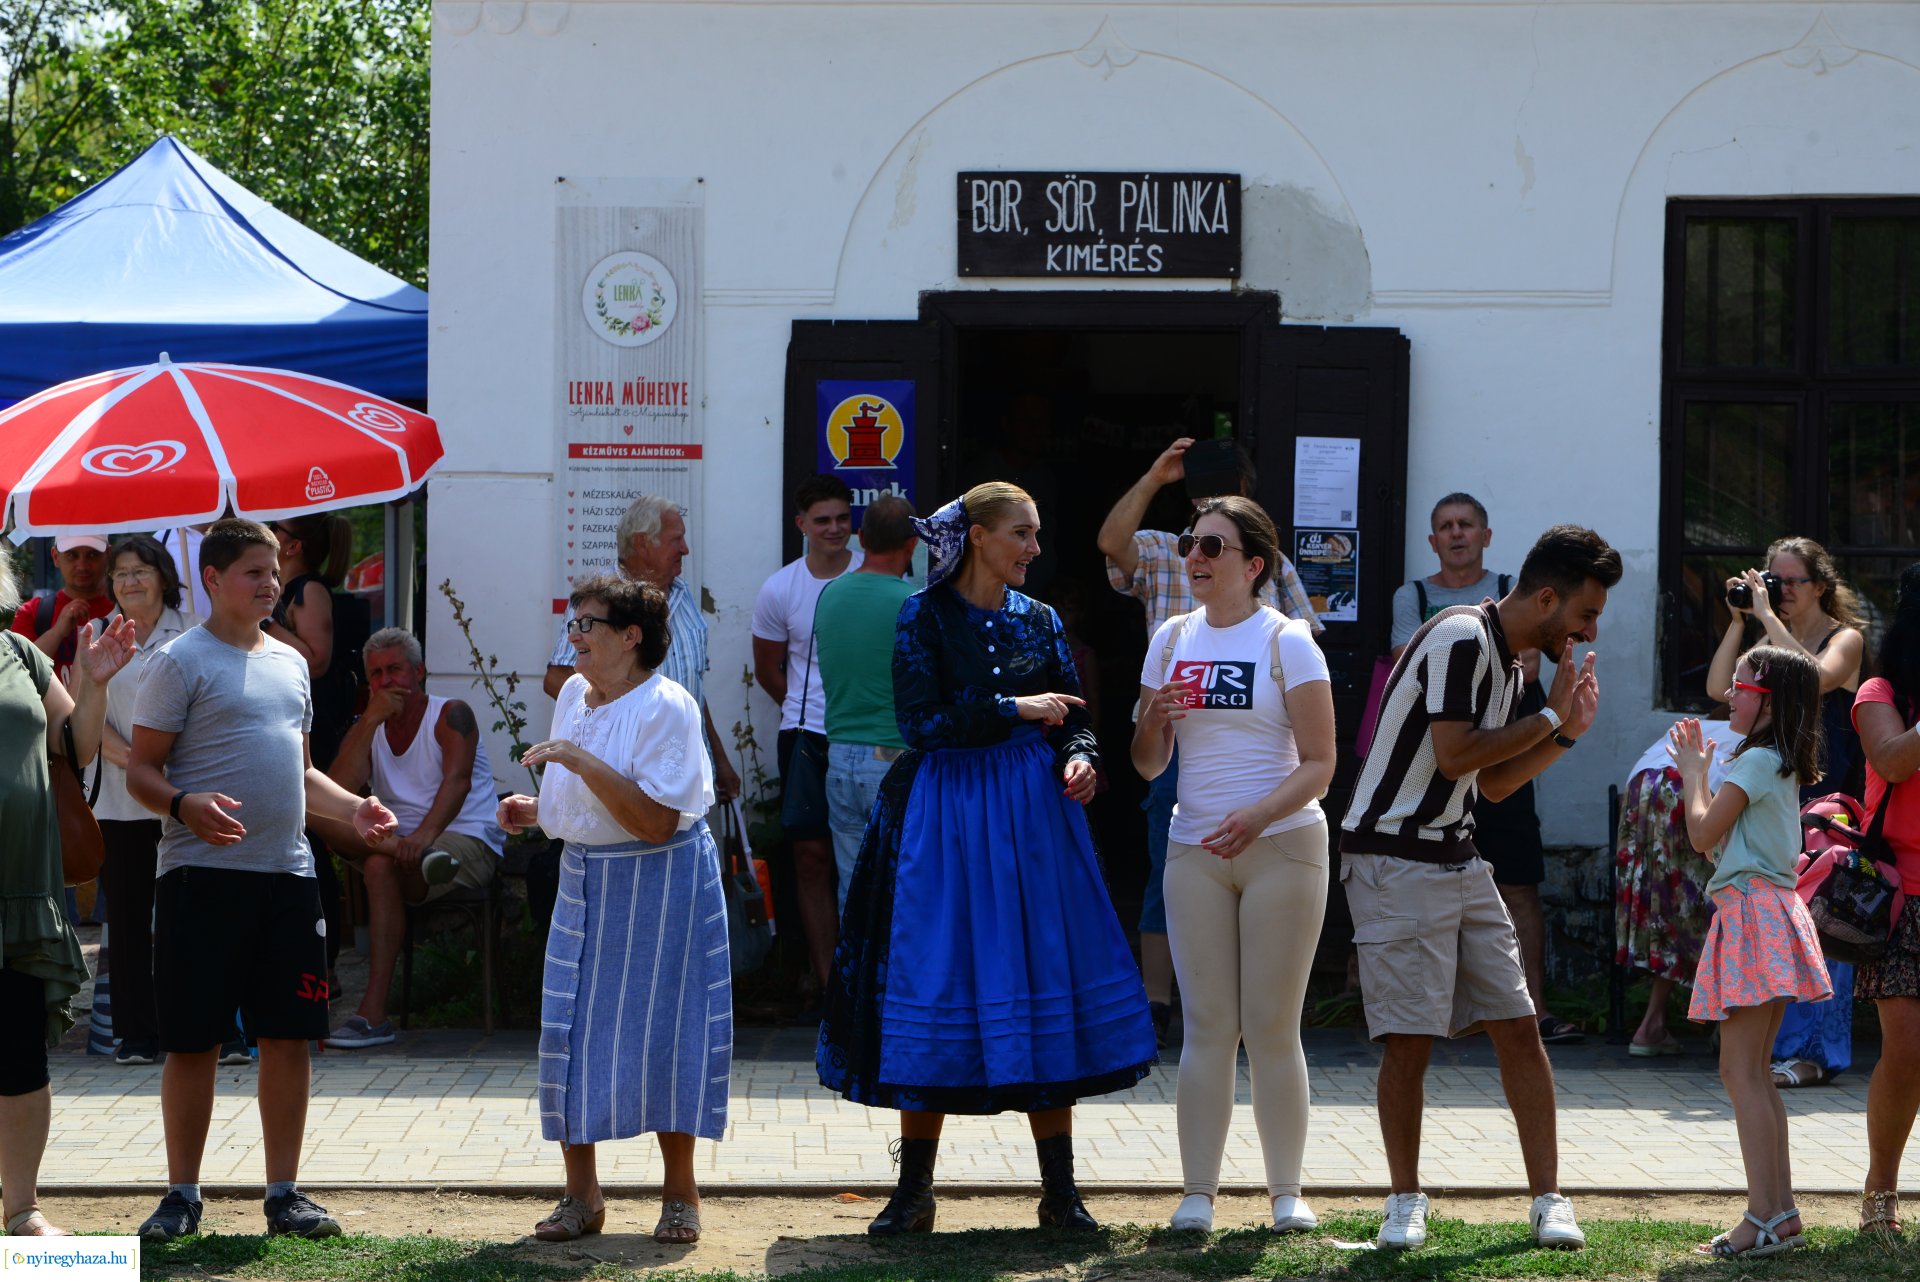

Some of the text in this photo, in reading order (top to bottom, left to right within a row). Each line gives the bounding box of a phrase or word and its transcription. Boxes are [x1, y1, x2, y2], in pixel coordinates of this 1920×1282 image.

[971, 174, 1229, 235] BOR, SÖR, PÁLINKA
[1046, 238, 1163, 272] KIMÉRÉS
[569, 376, 688, 406] LENKA MŰHELYE
[582, 446, 685, 457] KÉZMŰVES AJÁNDÉKOK:
[311, 485, 331, 496] PLASTIC
[582, 489, 642, 499] MÉZESKALÁCS
[850, 482, 907, 507] ank
[582, 506, 603, 516] HÁZI
[582, 557, 611, 567] NATÚR
